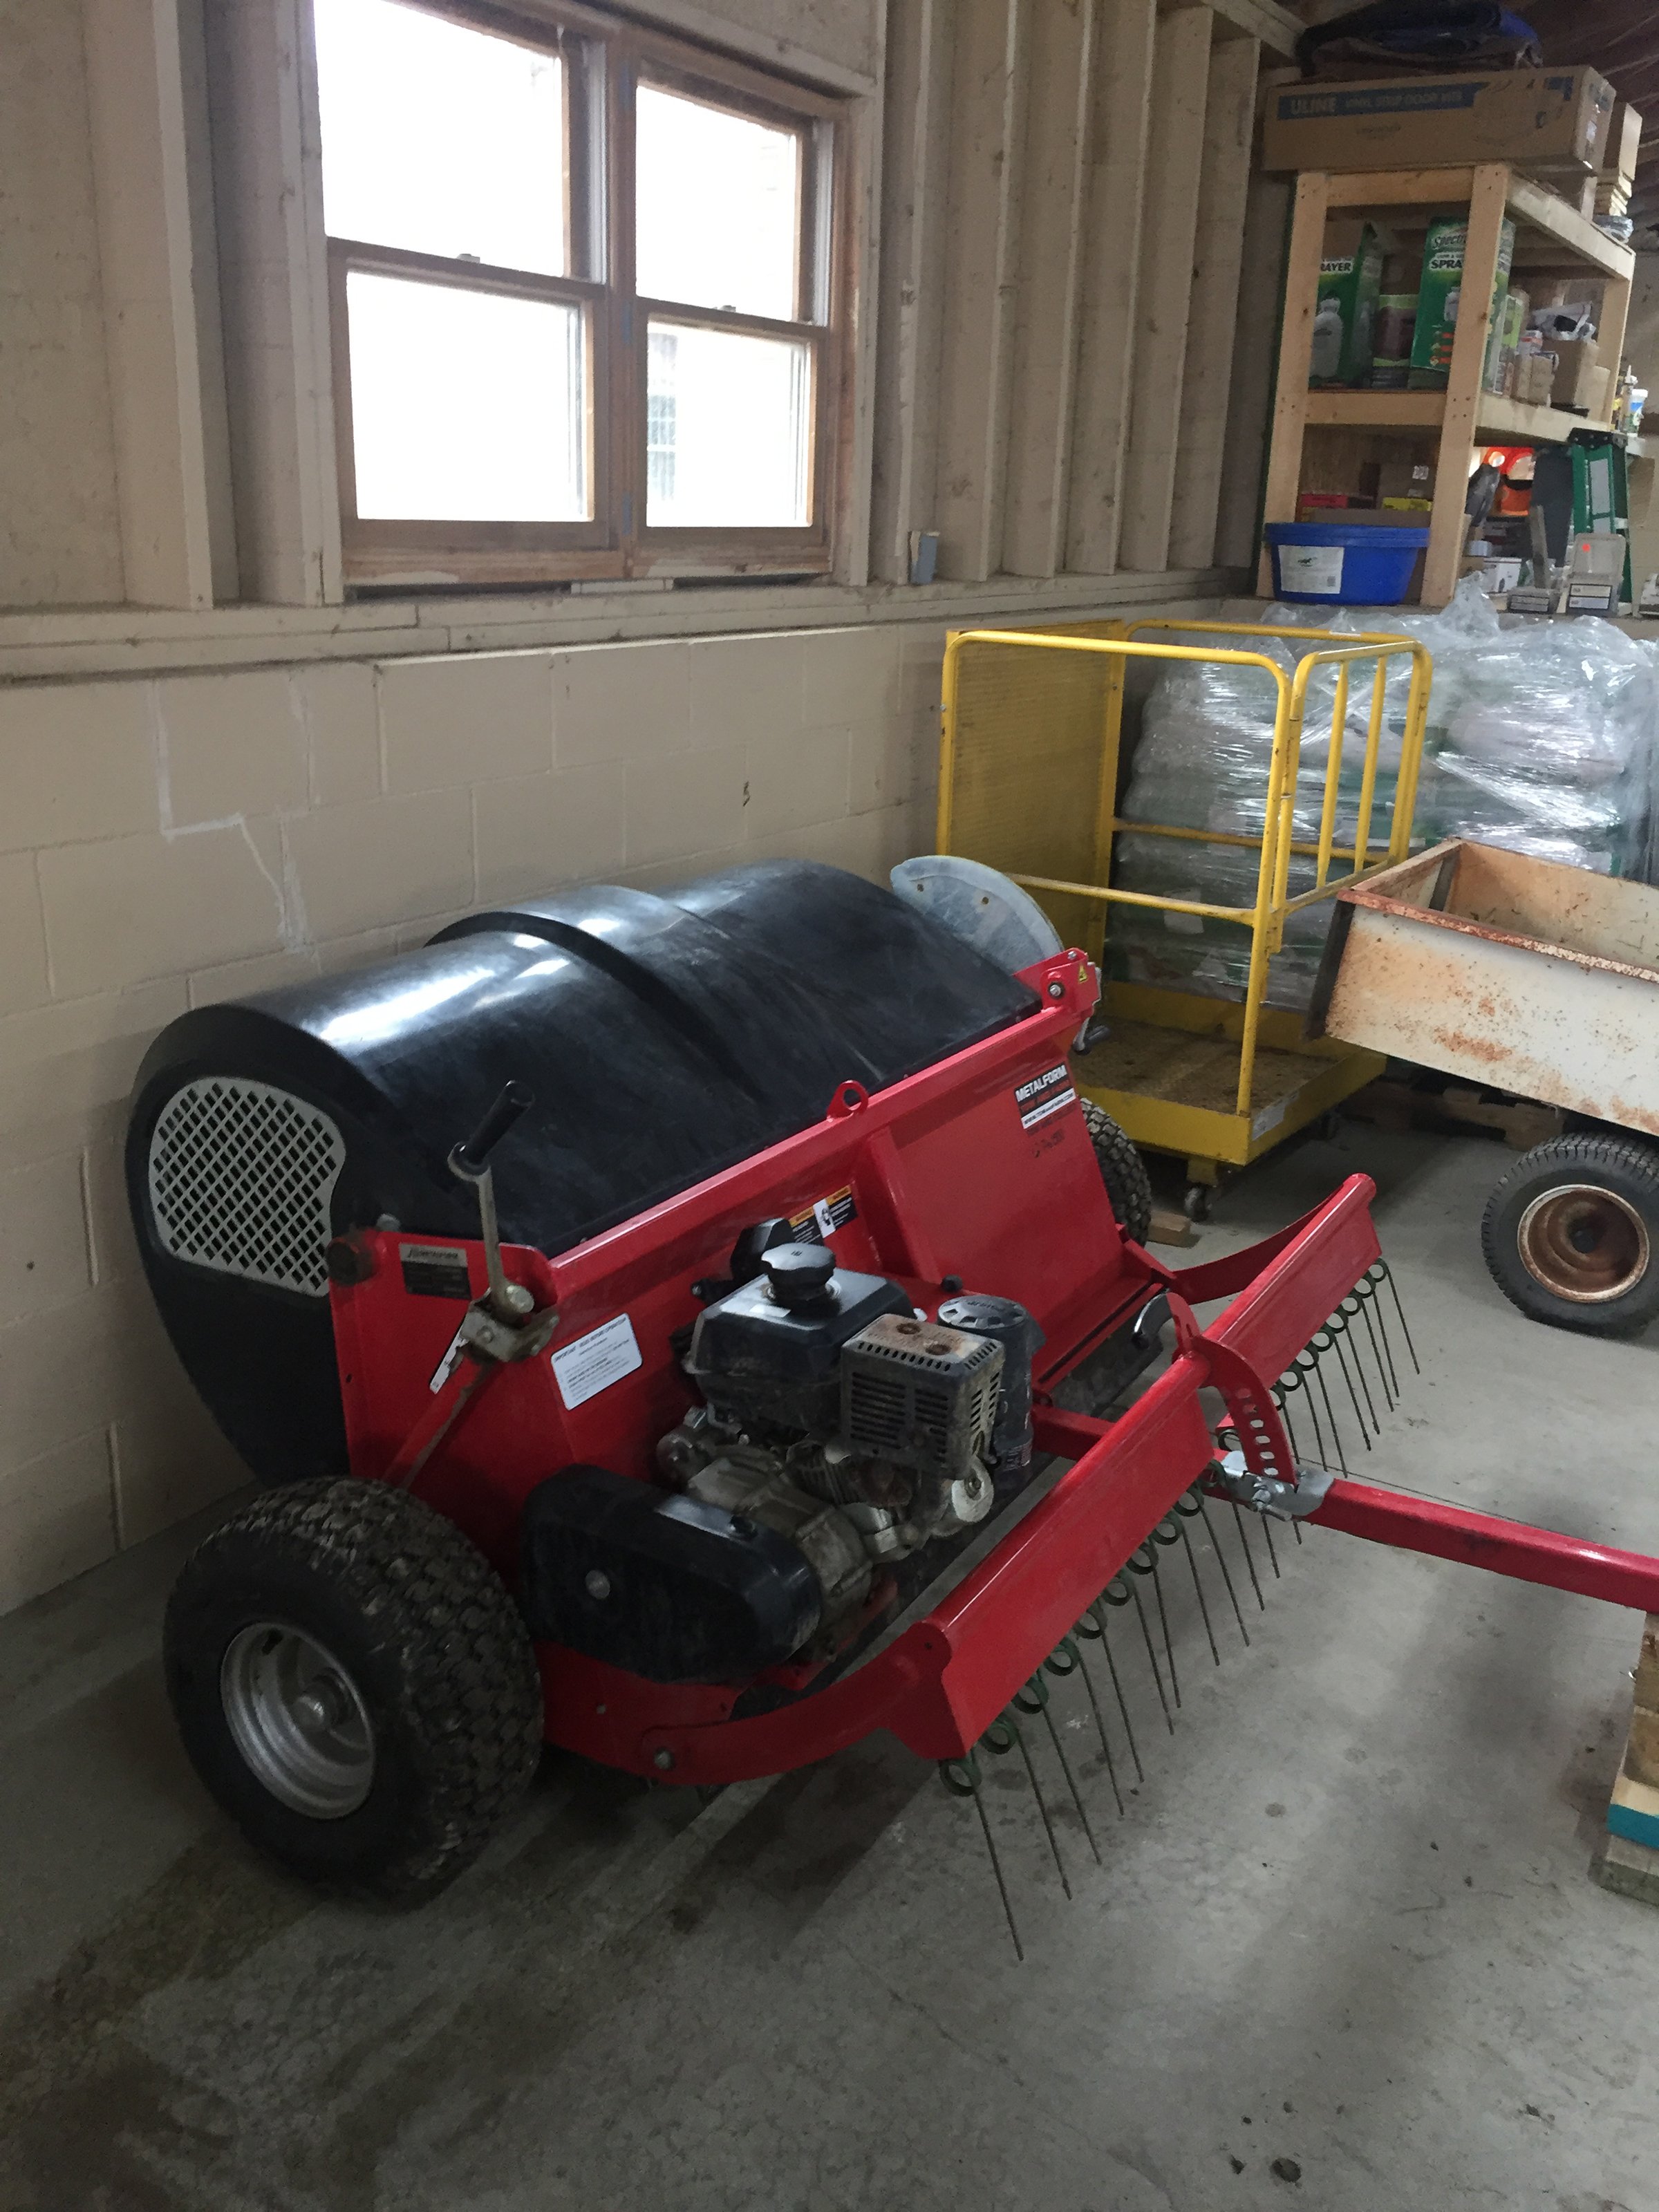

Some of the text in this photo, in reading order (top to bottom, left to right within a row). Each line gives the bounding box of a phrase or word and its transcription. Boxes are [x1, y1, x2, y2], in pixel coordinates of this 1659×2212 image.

[1291, 97, 1337, 115] ULINE
[1321, 263, 1351, 272] RAYER
[1431, 259, 1463, 269] SPRA
[1015, 1064, 1068, 1103] METALFORM
